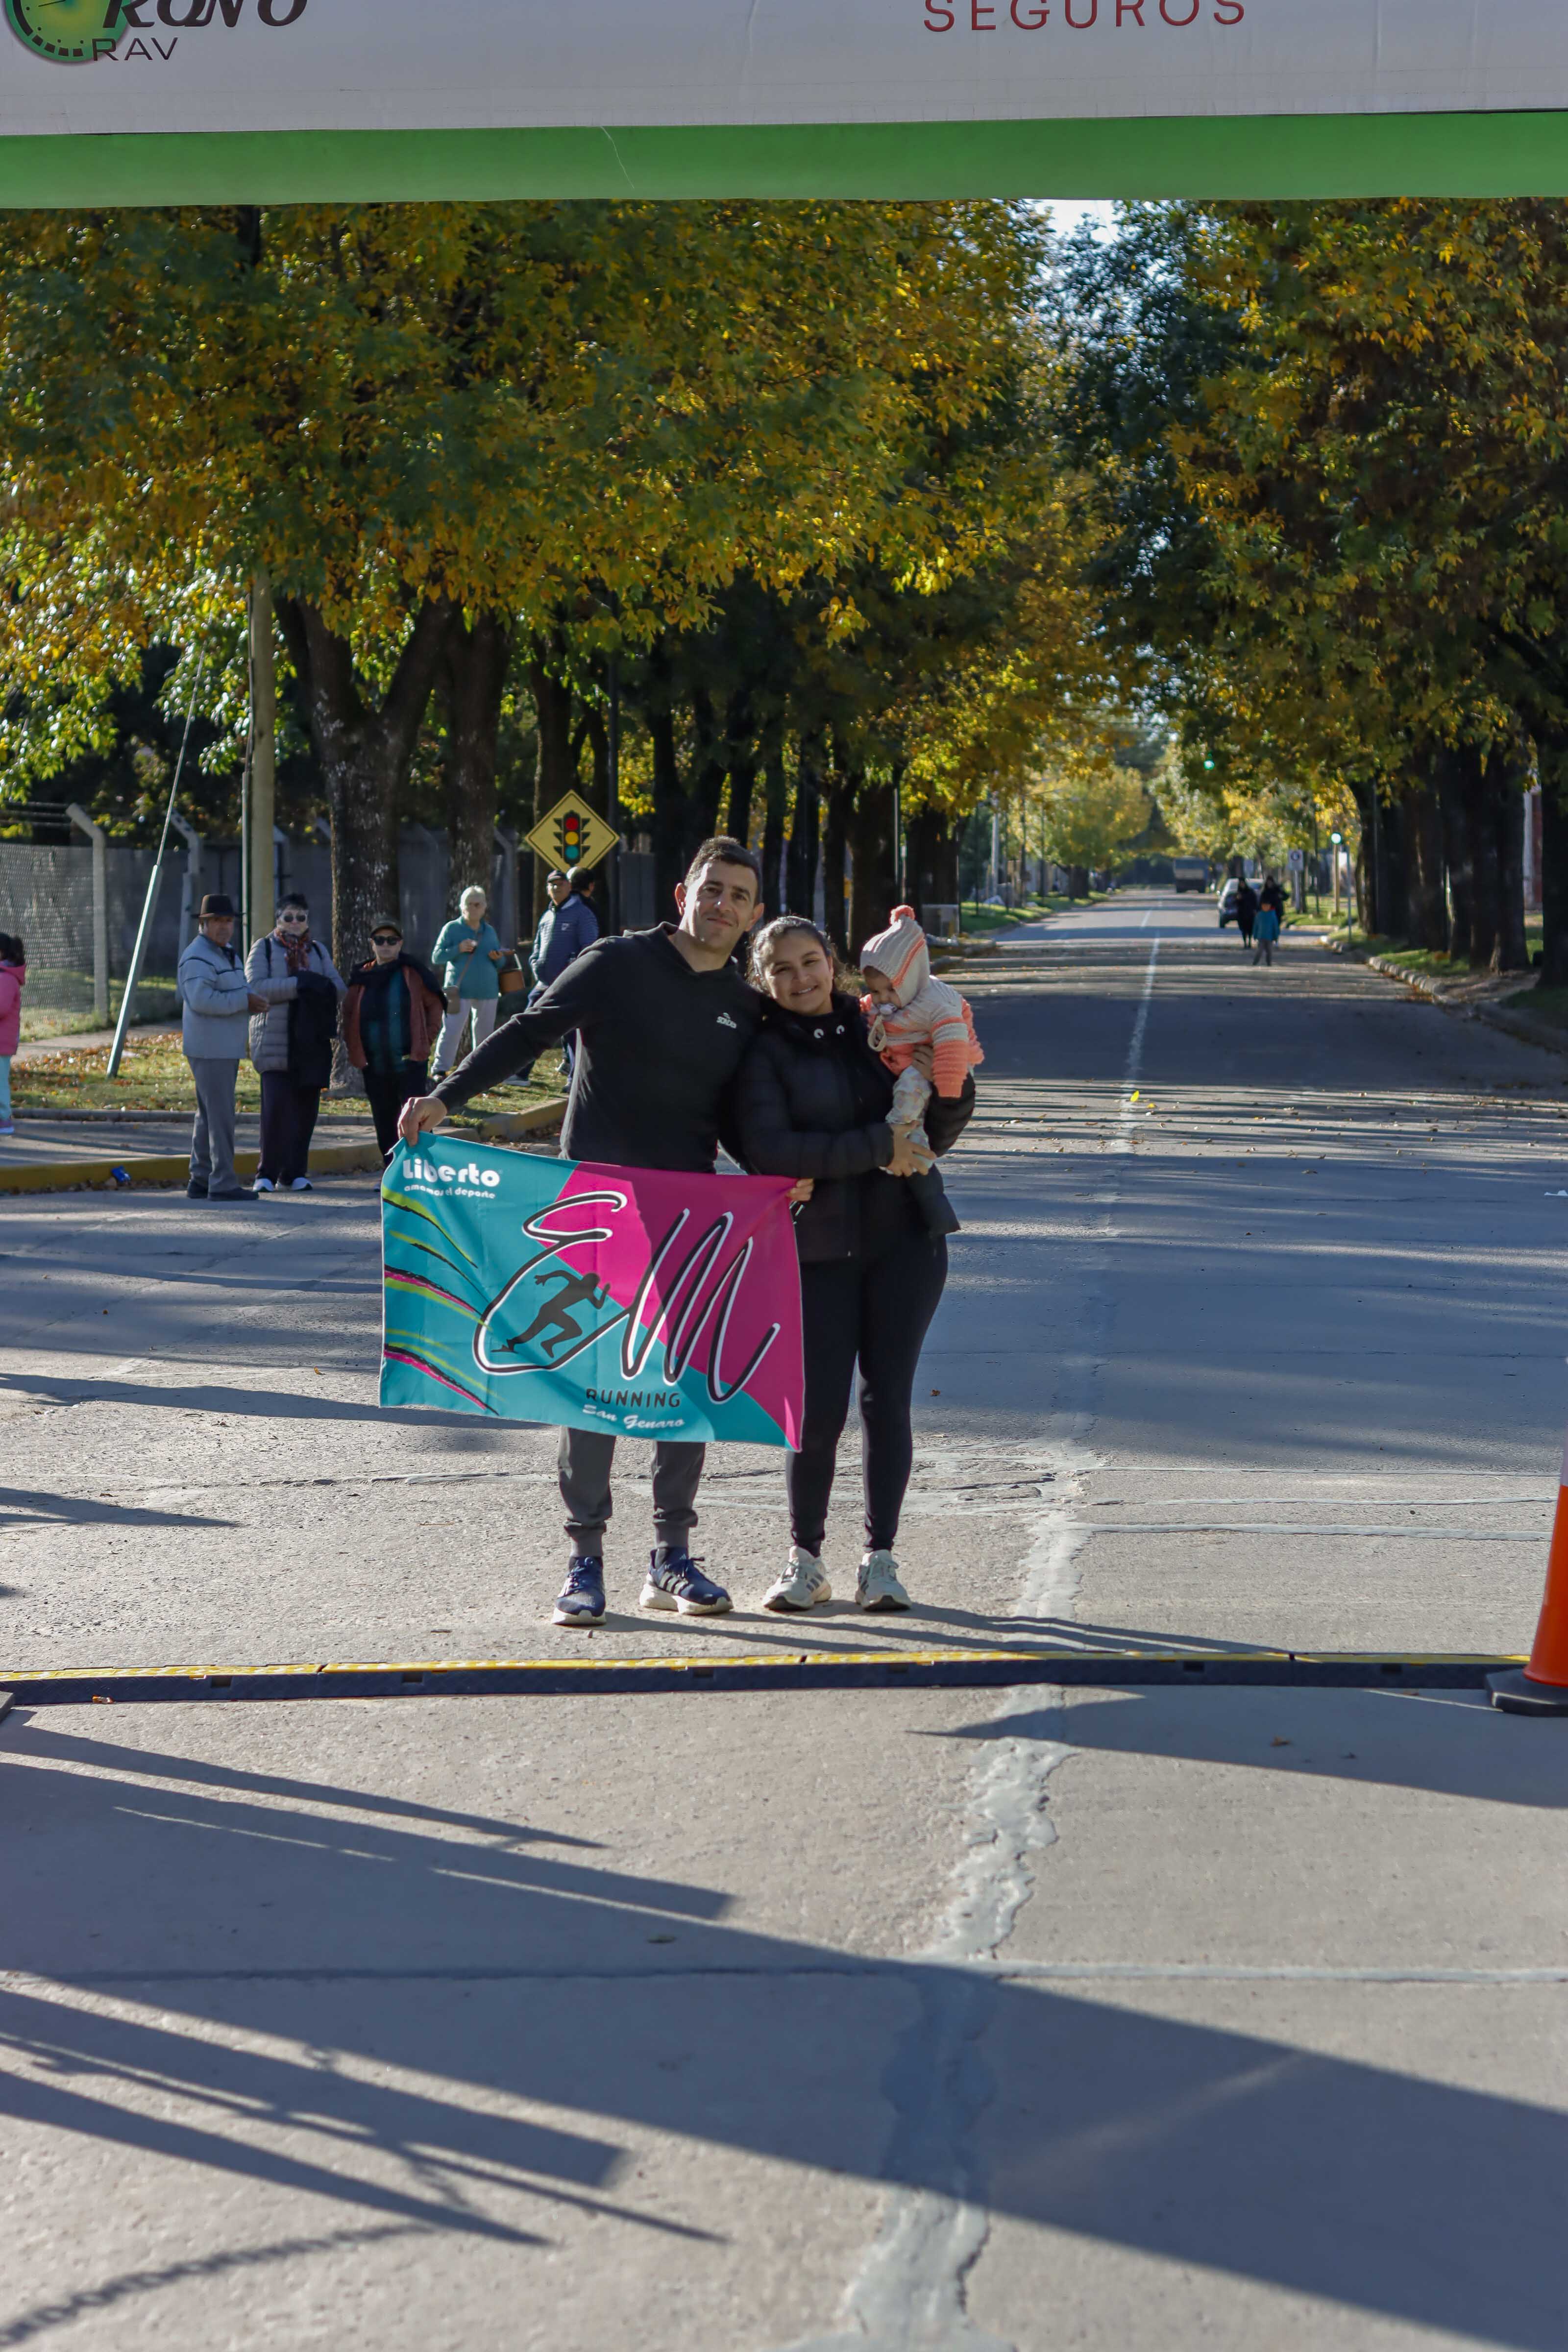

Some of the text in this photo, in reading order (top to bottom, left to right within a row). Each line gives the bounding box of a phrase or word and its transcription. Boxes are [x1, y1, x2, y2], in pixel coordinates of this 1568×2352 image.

[924, 0, 1245, 32] SEGUROS
[92, 37, 178, 61] RAV
[403, 1158, 500, 1187] Liberto
[454, 1187, 496, 1199] deporte
[586, 1388, 680, 1408] RUNNING
[582, 1404, 685, 1429] San Genaro
